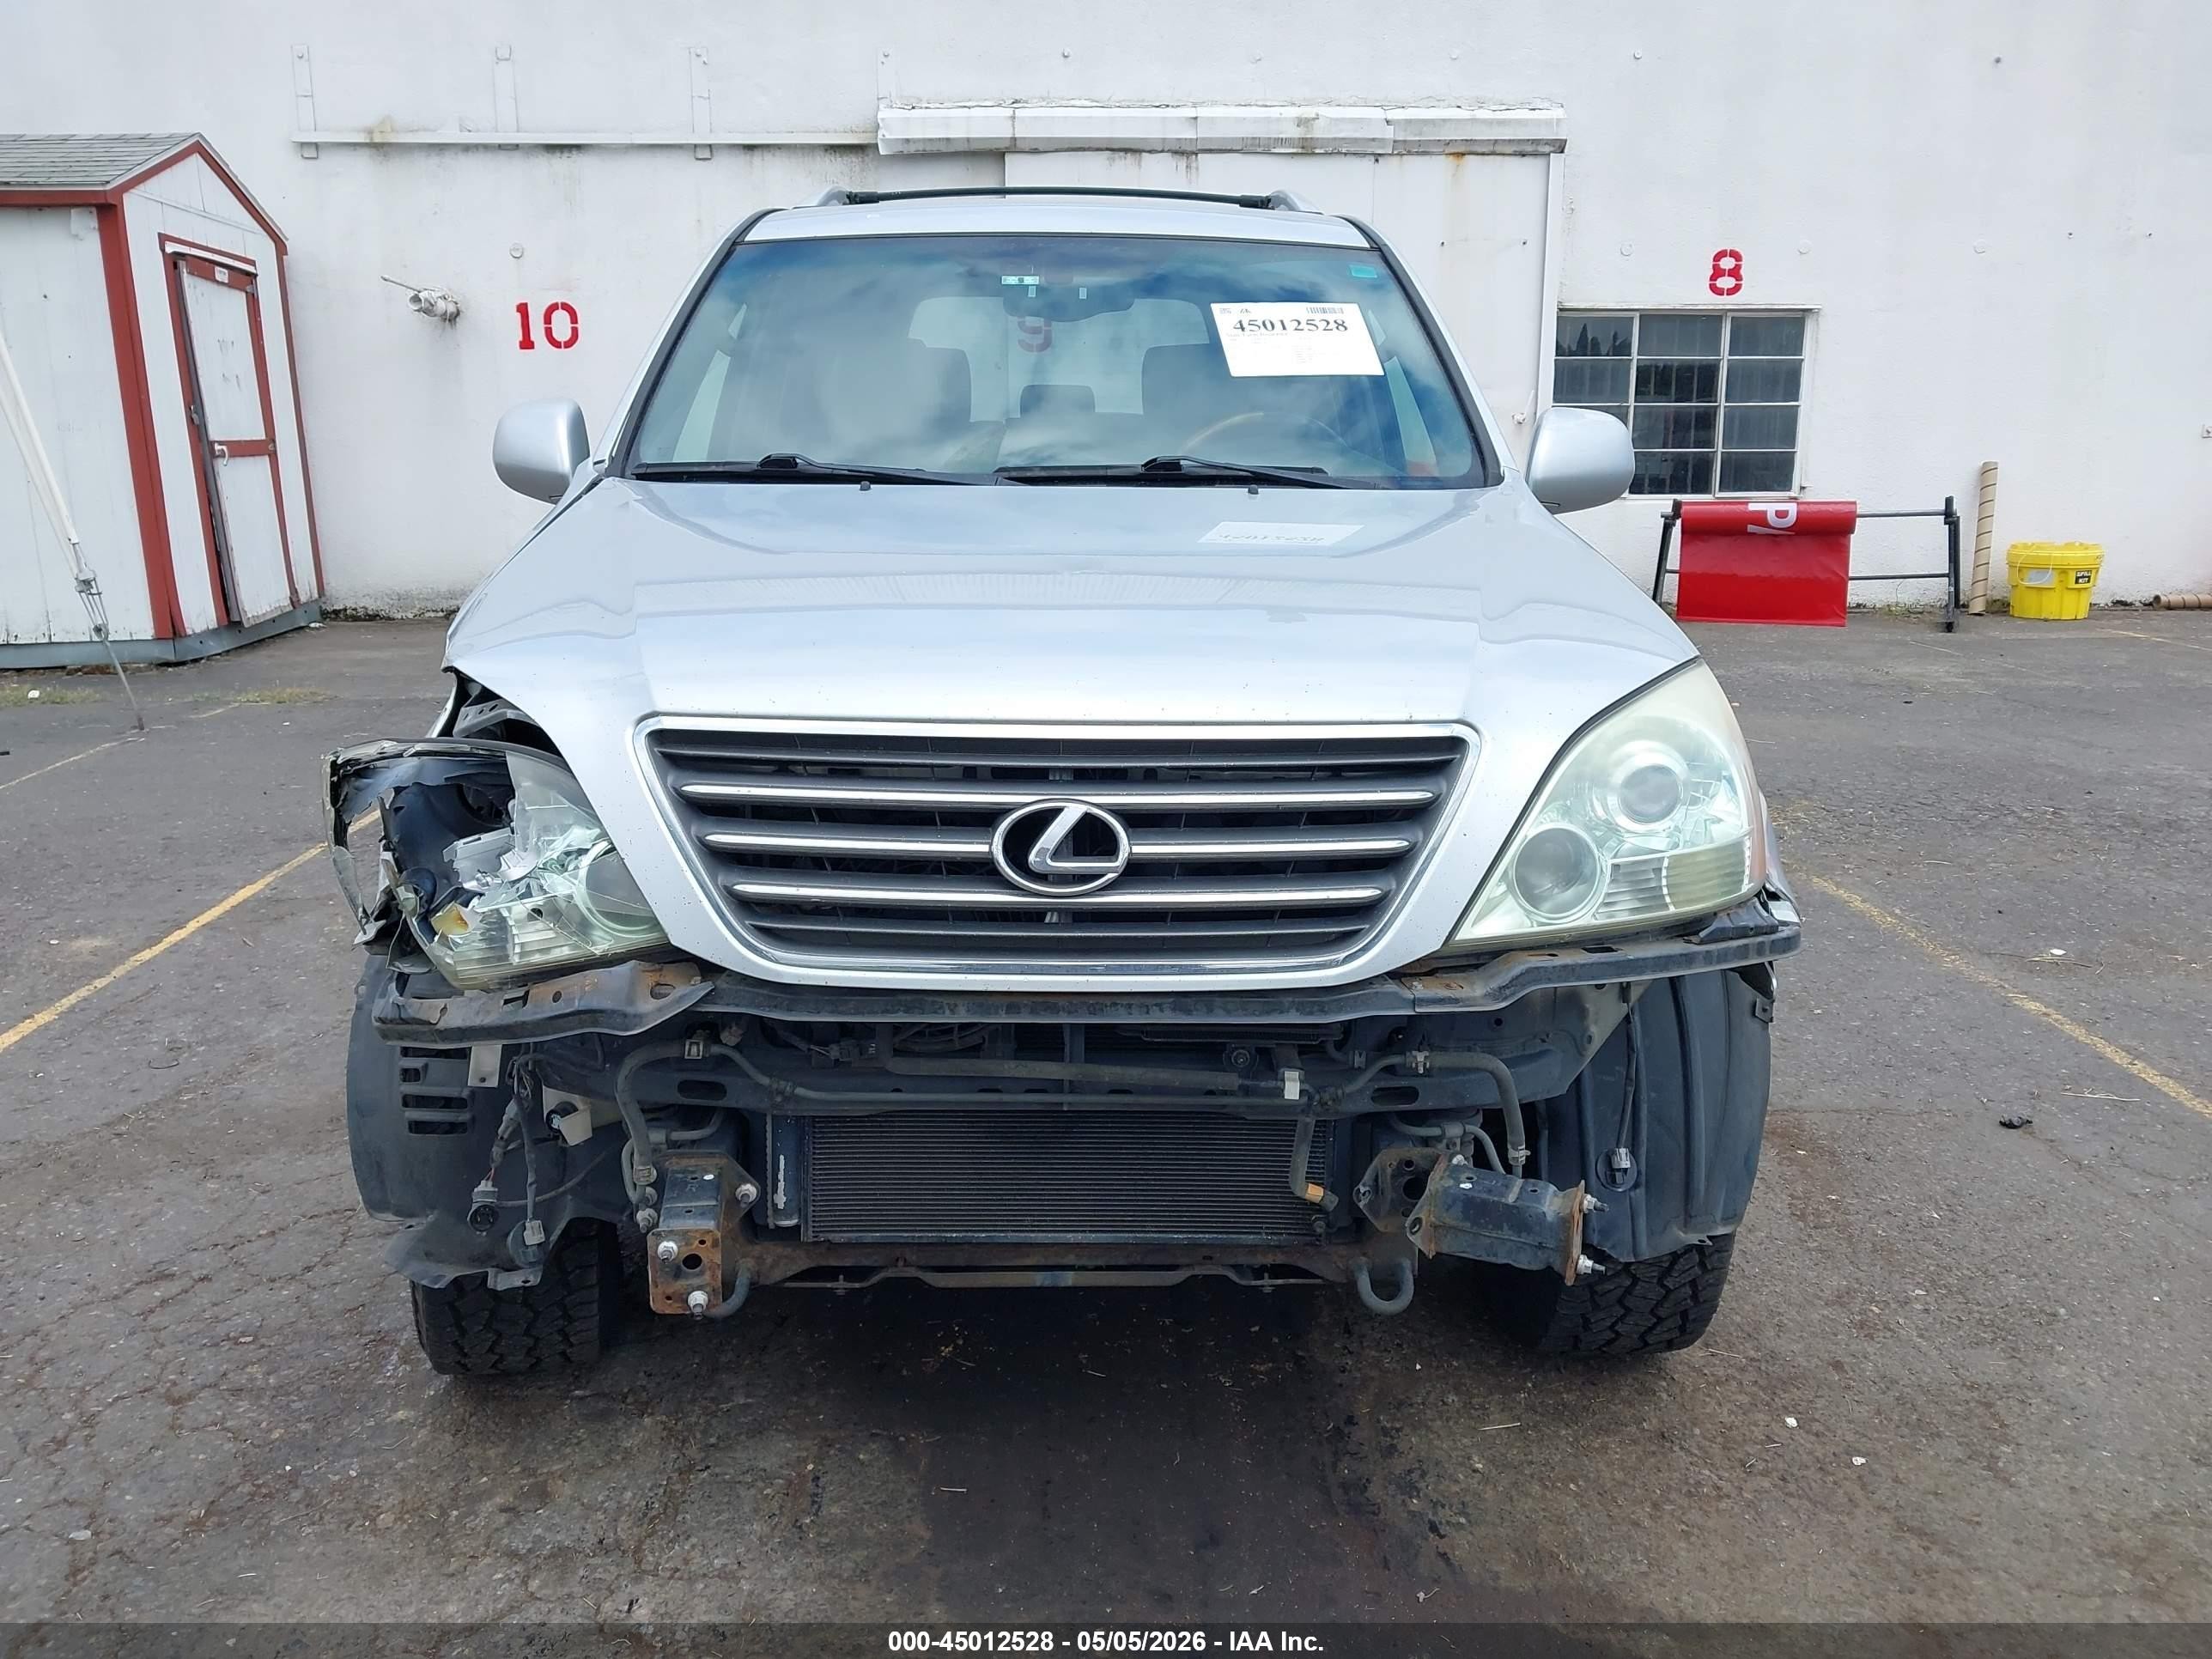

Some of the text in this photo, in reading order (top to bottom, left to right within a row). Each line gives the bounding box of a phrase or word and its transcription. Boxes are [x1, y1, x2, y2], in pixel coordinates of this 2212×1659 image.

[1710, 249, 1743, 296] 8
[516, 302, 579, 350] 10
[1233, 319, 1348, 332] 45012528
[1747, 502, 1797, 534] P
